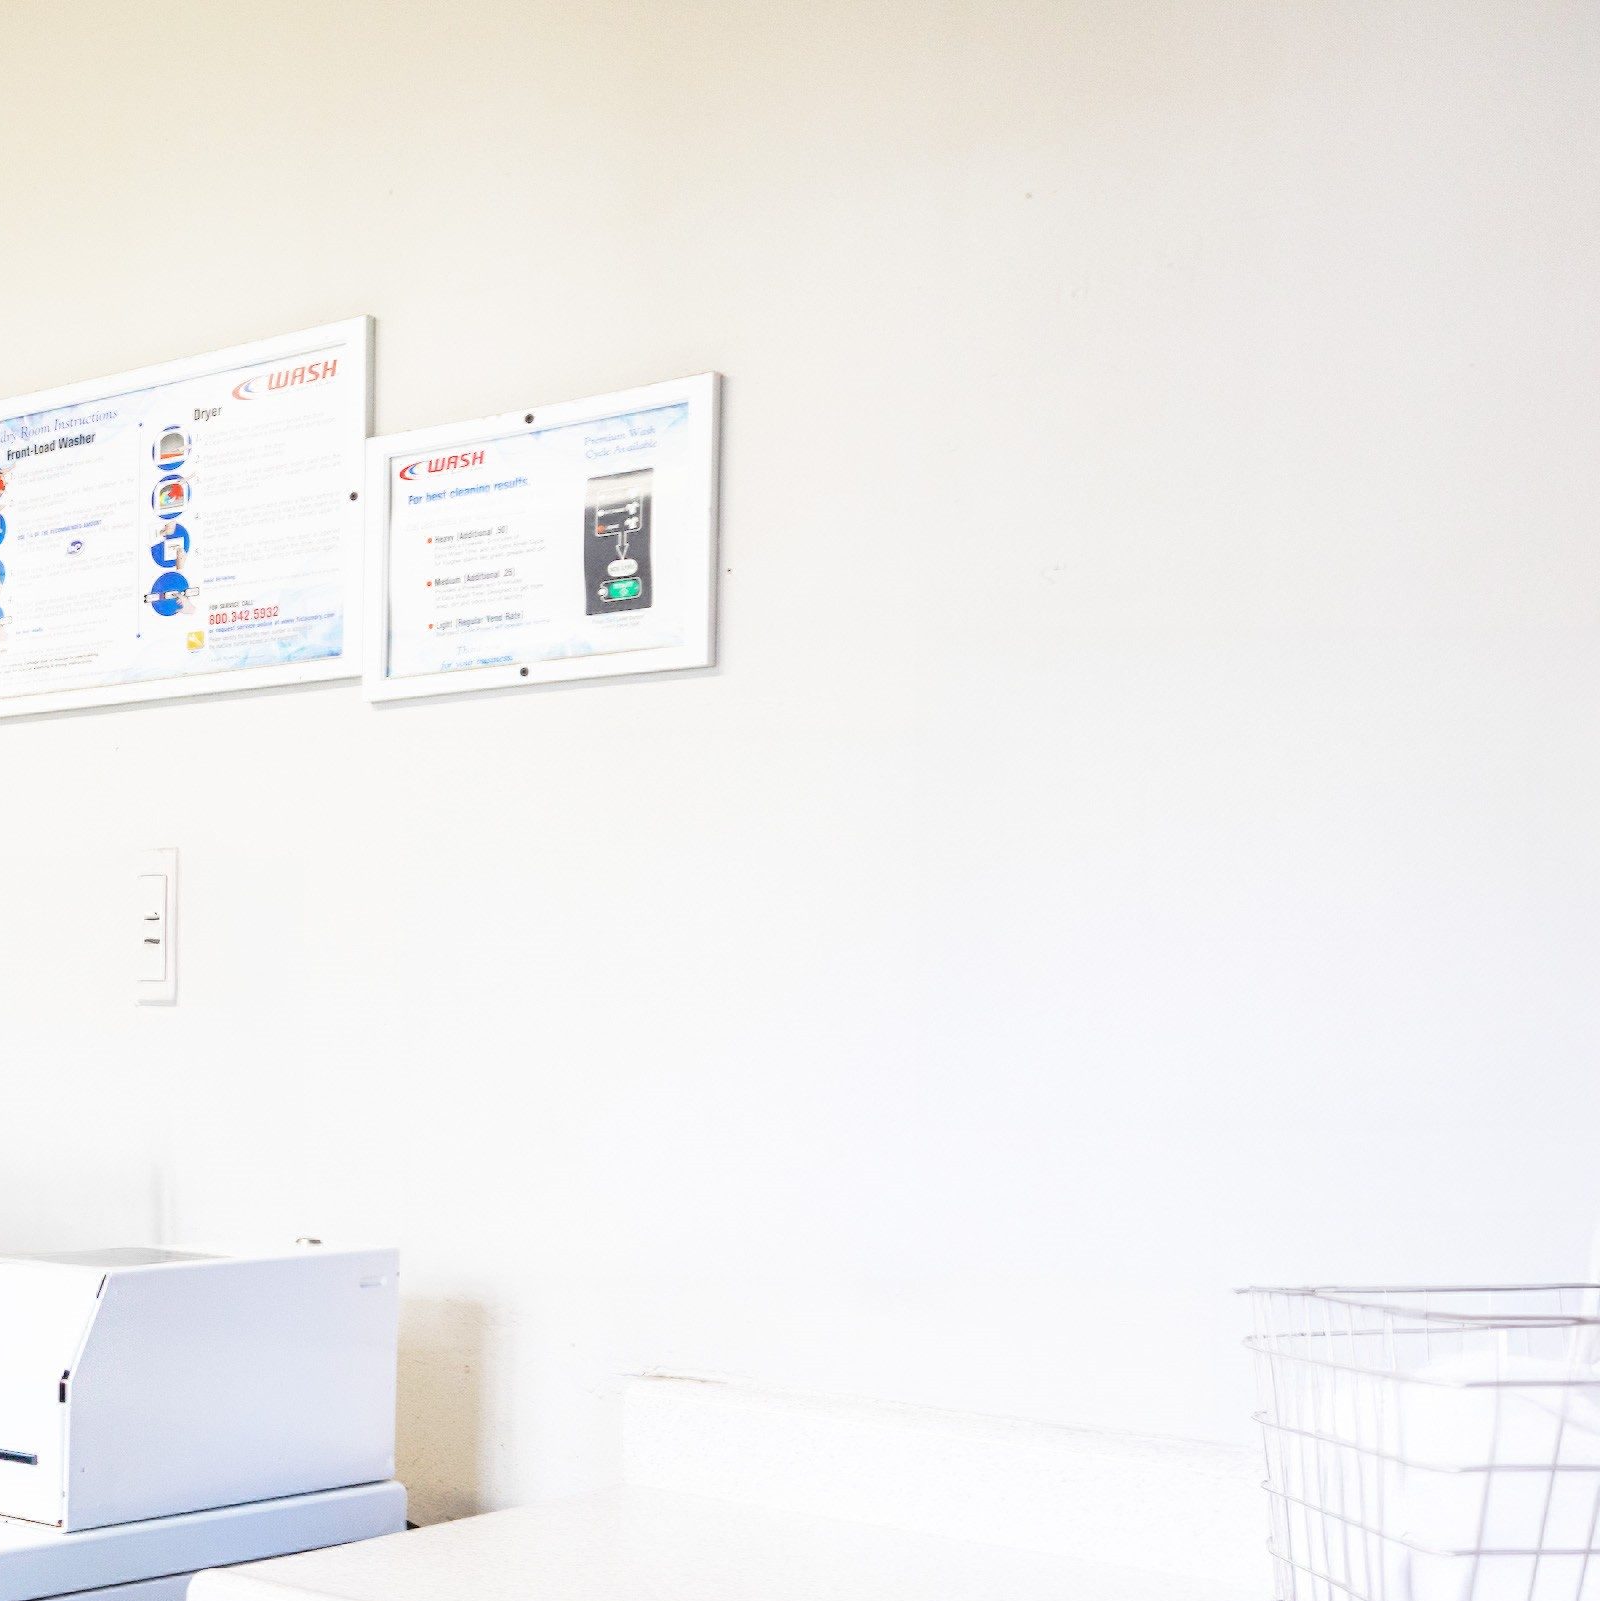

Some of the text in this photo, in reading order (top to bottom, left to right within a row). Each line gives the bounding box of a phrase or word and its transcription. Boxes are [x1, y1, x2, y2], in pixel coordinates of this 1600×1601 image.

[267, 359, 338, 391] WASH
[194, 405, 223, 421] Dryer
[20, 424, 50, 439] Room
[53, 411, 119, 432] Instructions
[585, 426, 656, 445] Premium Wash
[7, 432, 96, 461] Front-Load Washer
[585, 440, 657, 460] Cycle Available
[427, 450, 486, 473] WASH
[408, 494, 422, 505] For
[426, 490, 446, 503] best
[450, 482, 490, 498] cleaning
[434, 535, 454, 544] Heavy
[434, 576, 461, 587] Medium
[209, 605, 279, 625] 800.342.5932
